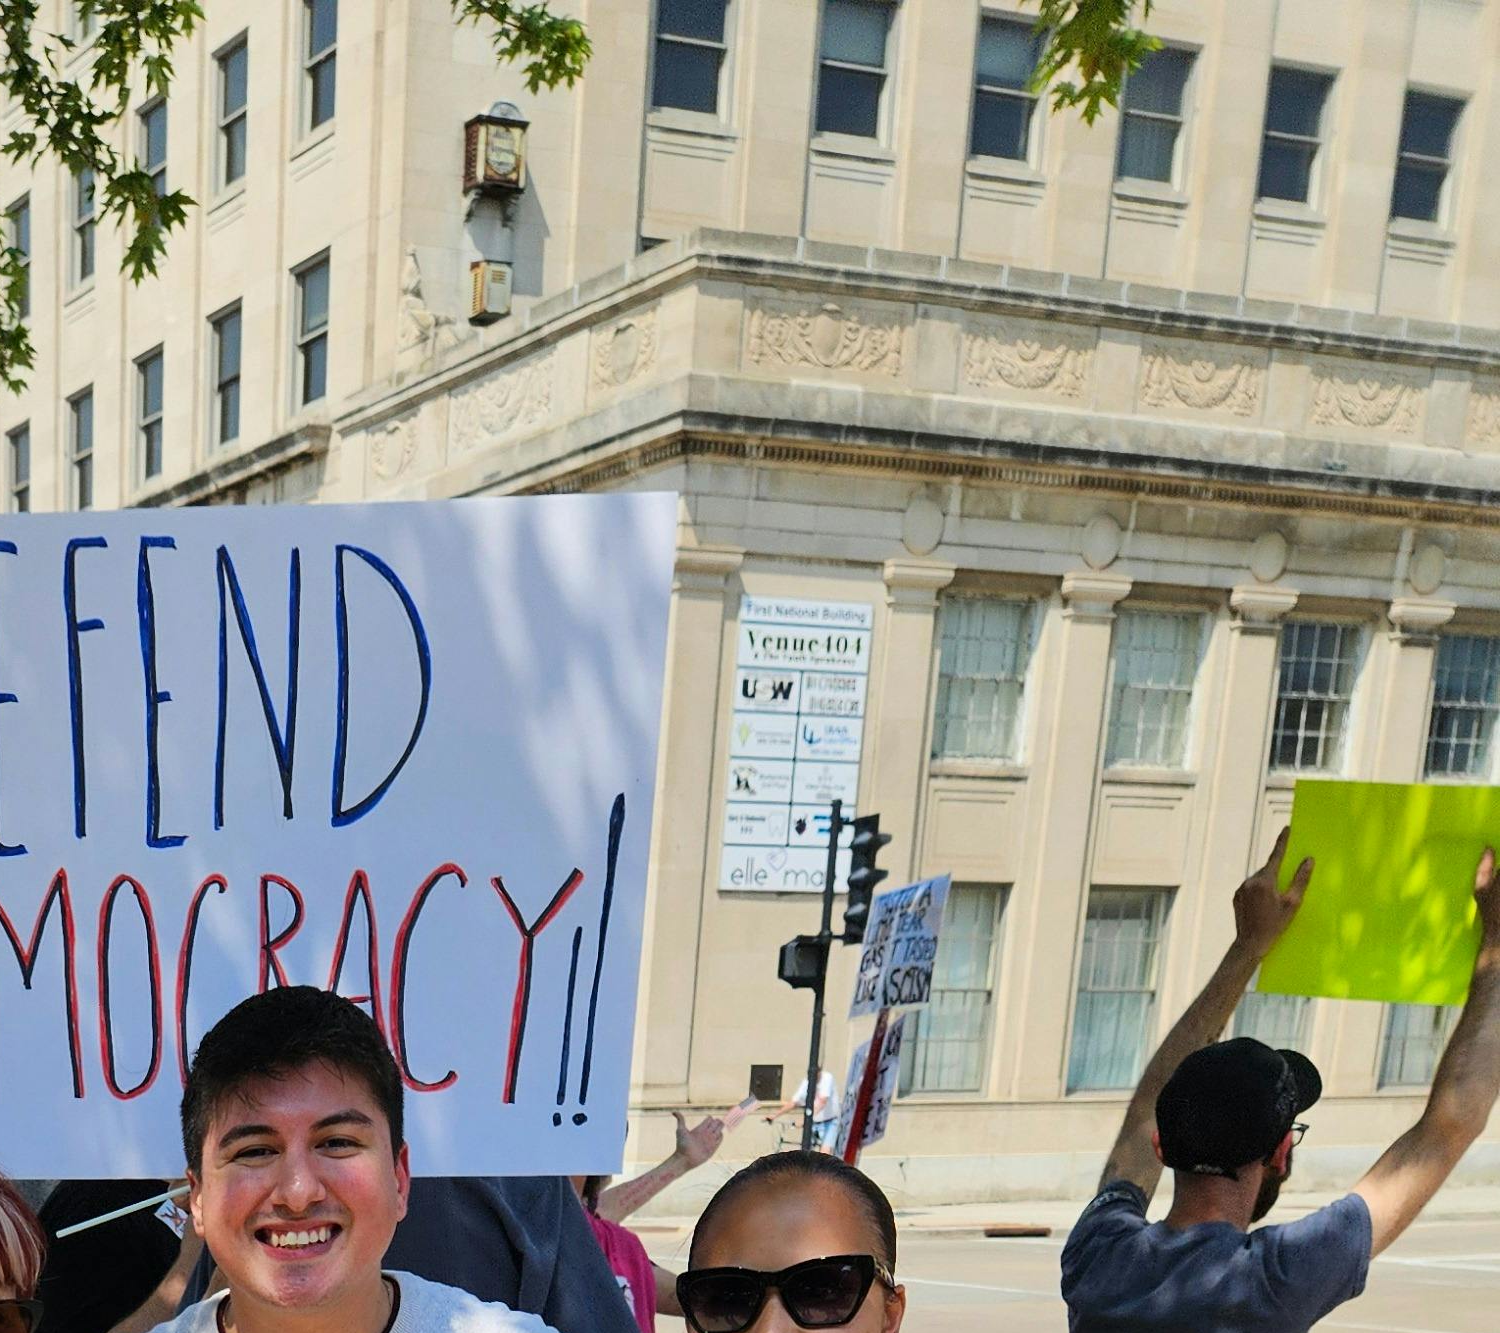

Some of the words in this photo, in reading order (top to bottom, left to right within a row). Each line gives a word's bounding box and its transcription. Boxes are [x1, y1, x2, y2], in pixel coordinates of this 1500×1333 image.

[775, 605, 819, 618] National
[822, 608, 867, 624] Building
[747, 629, 863, 656] Venue404
[730, 856, 768, 886] elle
